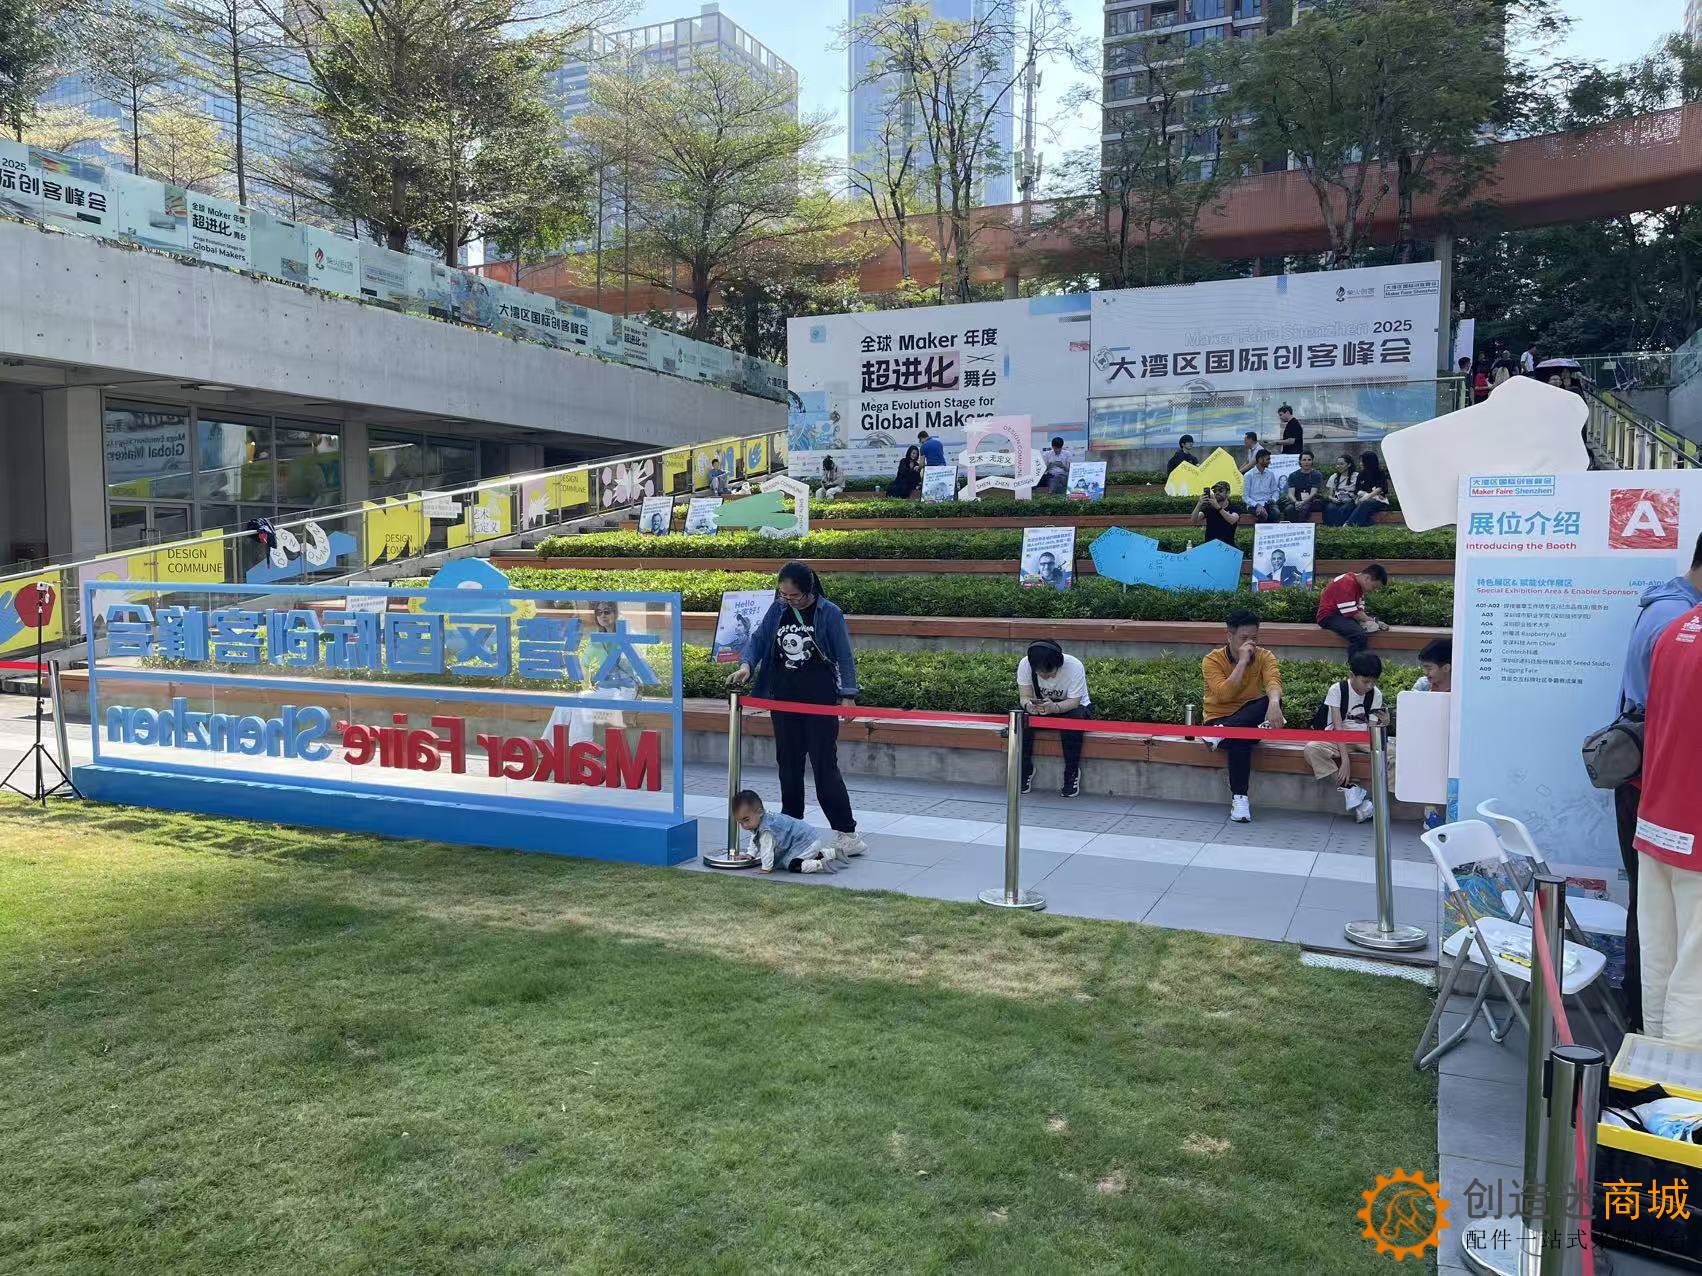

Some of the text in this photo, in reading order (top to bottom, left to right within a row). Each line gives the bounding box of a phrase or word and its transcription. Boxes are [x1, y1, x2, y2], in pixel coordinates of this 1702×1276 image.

[2, 158, 27, 171] 2025
[192, 202, 246, 225] 全球 Maker 年度
[192, 214, 232, 236] 超进化
[193, 242, 246, 261] Global Makers
[499, 304, 589, 337] 大湾区国际创客峰会
[1373, 320, 1412, 334] 2025
[861, 328, 997, 353] 全球 Maker 年度
[1109, 338, 1412, 381] 大湾区国际创客峰会
[861, 355, 996, 393] 超进化 舞台
[862, 397, 995, 414] Mega Evolution Stage for
[862, 412, 919, 431] Global
[1014, 478, 1034, 487] DESIGN
[1472, 486, 1553, 496] Maker Faire Shenzhen
[1468, 511, 1581, 536] 展位介绍
[1621, 500, 1666, 537] A
[385, 533, 413, 543] DESIGN
[1466, 542, 1577, 551] Introducing the Booth
[168, 549, 207, 560] DESIGN
[168, 562, 223, 574] COMMUNE
[1476, 588, 1504, 596] Special
[1602, 589, 1639, 597] Sponsors
[735, 600, 755, 608] Hello
[1501, 667, 1522, 675] Hugging
